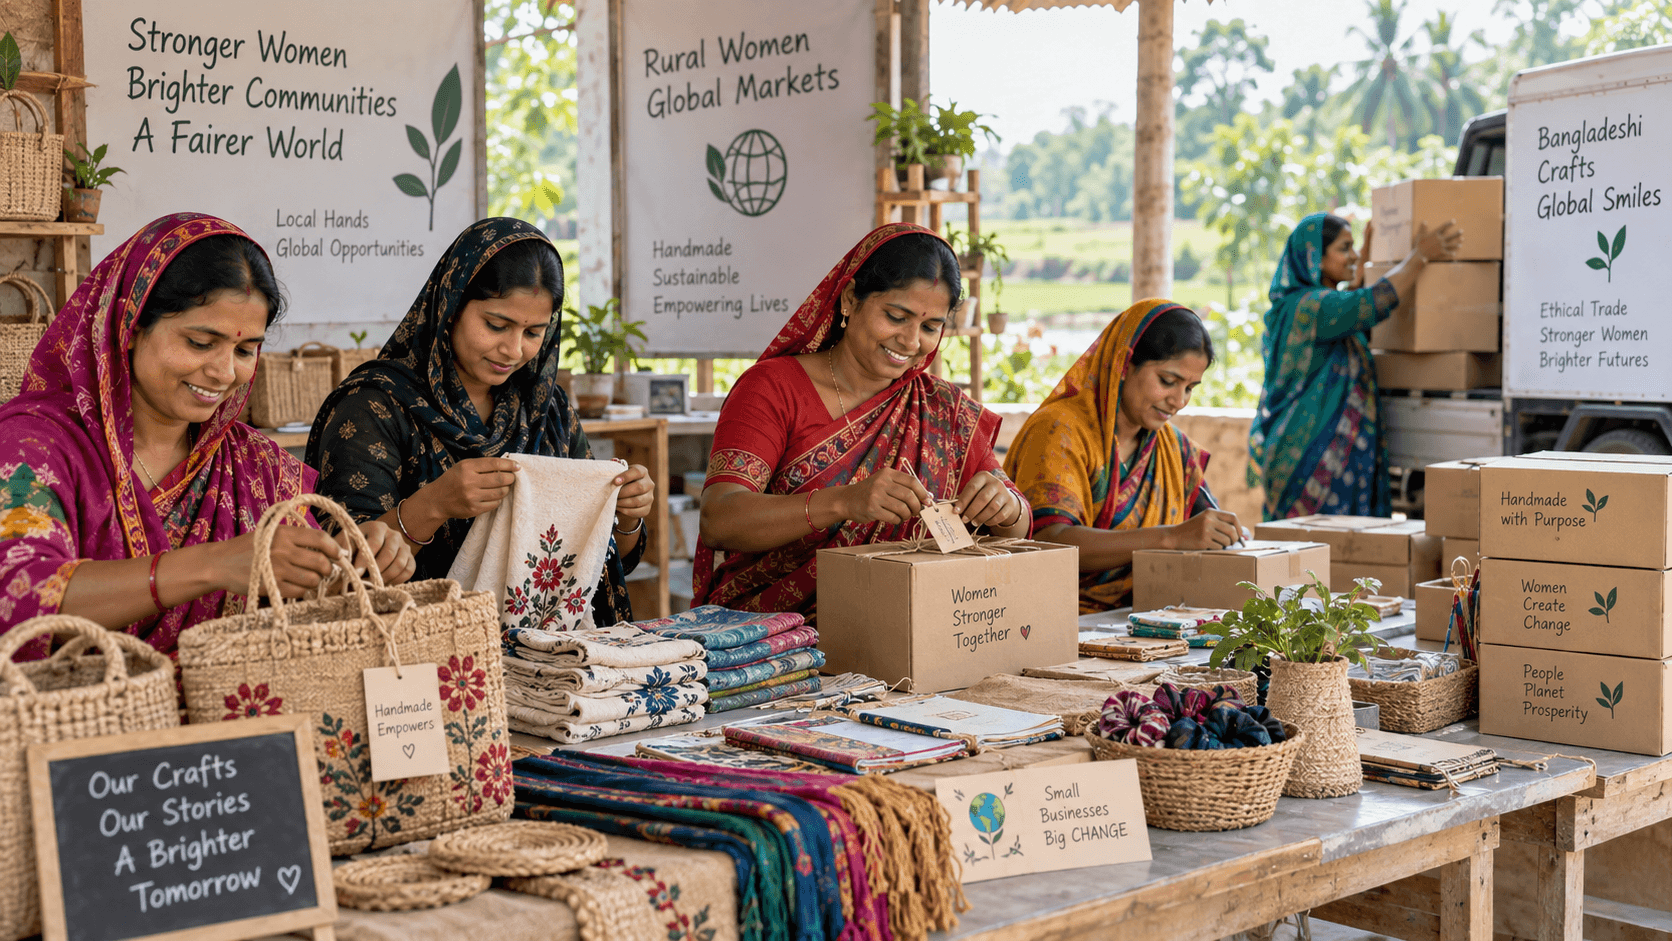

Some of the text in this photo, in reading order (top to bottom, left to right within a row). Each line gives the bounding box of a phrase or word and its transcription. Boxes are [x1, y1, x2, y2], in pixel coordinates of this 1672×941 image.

[127, 17, 347, 70] Stronger Women
[643, 31, 810, 78] Rural Women
[126, 65, 397, 118] Brighter Communities
[647, 63, 840, 119] Global Markets
[131, 116, 344, 161] A Fairer World
[1537, 113, 1643, 155] Bangladeshi
[1537, 154, 1595, 184] Crafts
[1537, 181, 1662, 220] Global Smiles
[276, 208, 370, 229] Local Hands
[276, 237, 425, 264] Global Opportunities
[653, 236, 733, 258] Handmade
[653, 265, 740, 287] Sustainable
[653, 293, 789, 321] Empowering Lives
[1540, 298, 1628, 319] Ethical Trade
[1539, 324, 1648, 349] Stronger Women
[1539, 350, 1649, 374] Brighter Futures
[1500, 491, 1568, 507] Handmade
[1500, 510, 1587, 533] with Purpose
[951, 586, 998, 605] Women
[1521, 578, 1567, 594] Women
[952, 606, 1007, 627] Stronger
[1523, 596, 1566, 613] Create
[1523, 614, 1571, 637] Change
[952, 626, 1011, 653] Together
[1523, 663, 1565, 686] People
[1523, 682, 1565, 699] Planet
[374, 698, 433, 718] Handmade
[1522, 700, 1589, 725] Prosperity
[377, 719, 435, 739] Empowers
[88, 754, 238, 799] Our Crafts
[1044, 782, 1080, 802] Small
[99, 791, 251, 837] Our Stories
[1039, 804, 1110, 824] Businesses
[1043, 821, 1129, 851] Big CHANGE
[114, 828, 255, 876] A Brighter
[129, 866, 262, 913] Tomorrow
